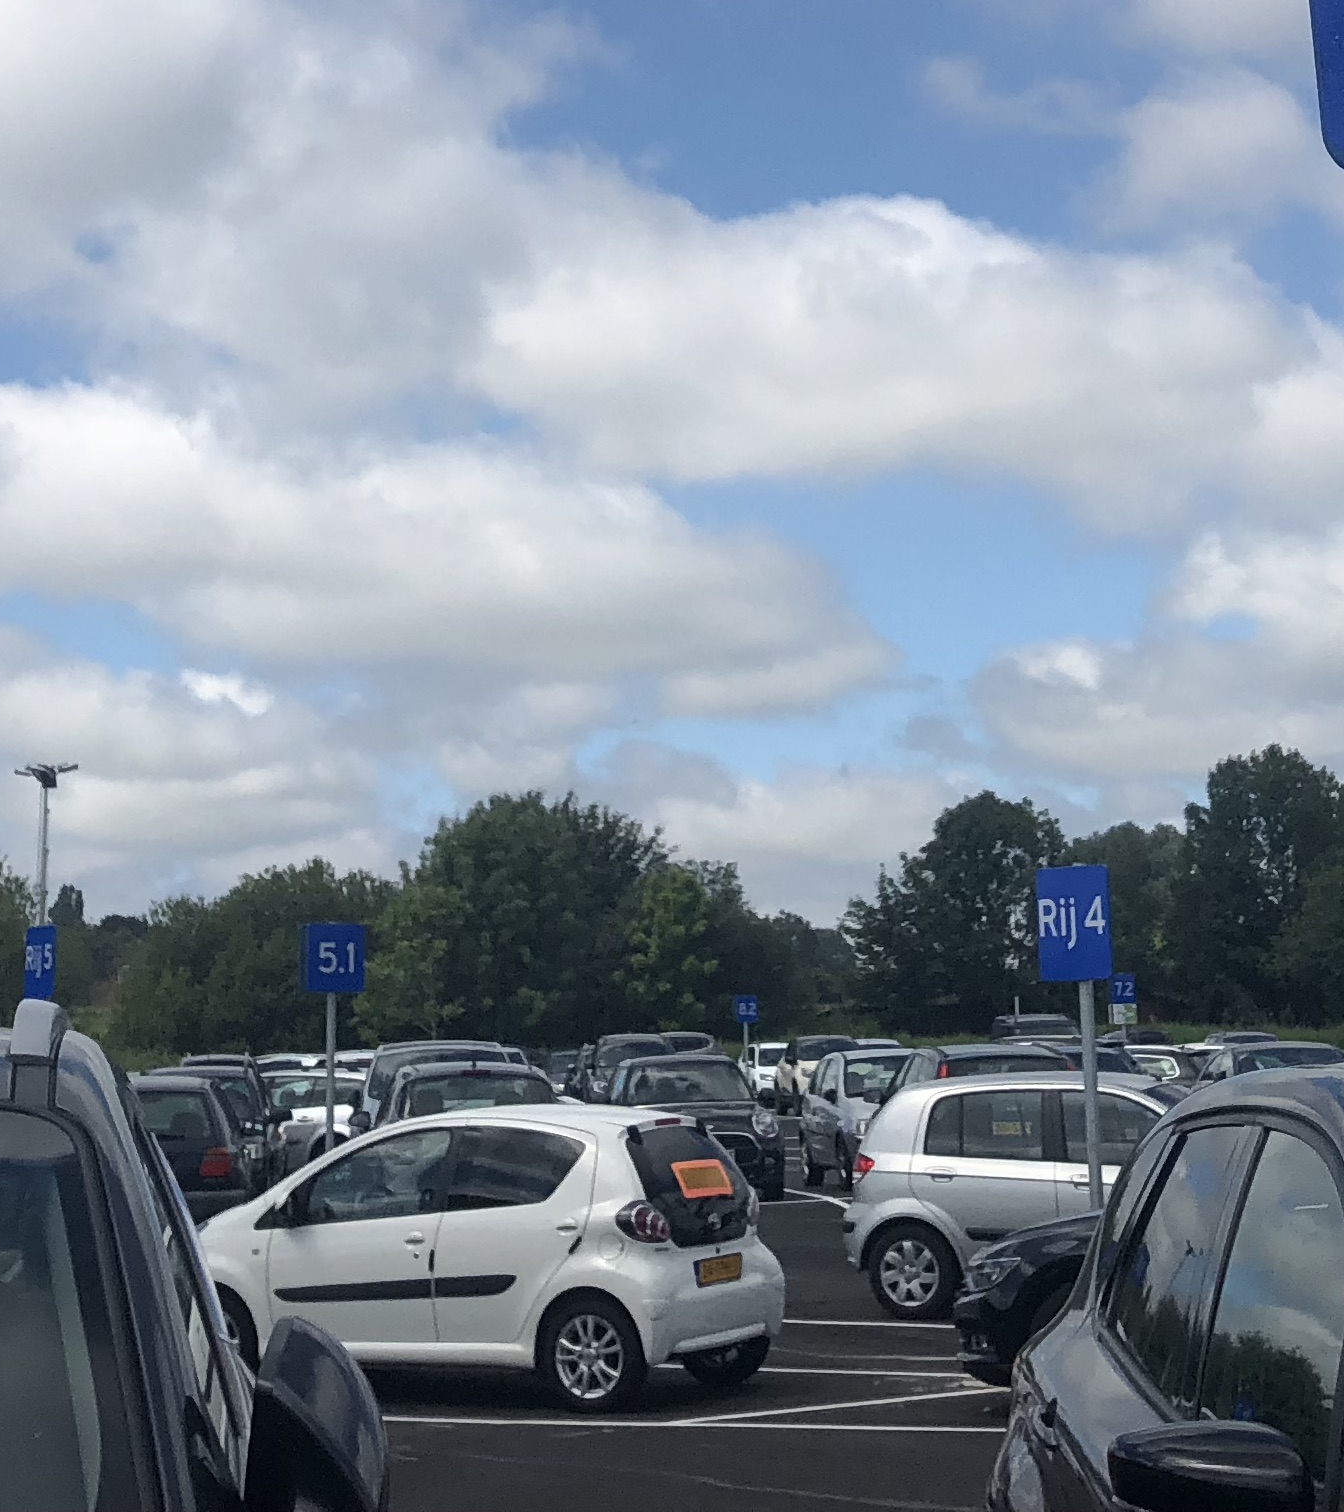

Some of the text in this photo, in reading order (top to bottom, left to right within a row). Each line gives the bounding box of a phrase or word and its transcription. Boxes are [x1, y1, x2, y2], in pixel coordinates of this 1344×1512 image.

[1037, 894, 1106, 949] Rij 4
[24, 942, 54, 979] Rij 5
[318, 941, 355, 974] 5.1
